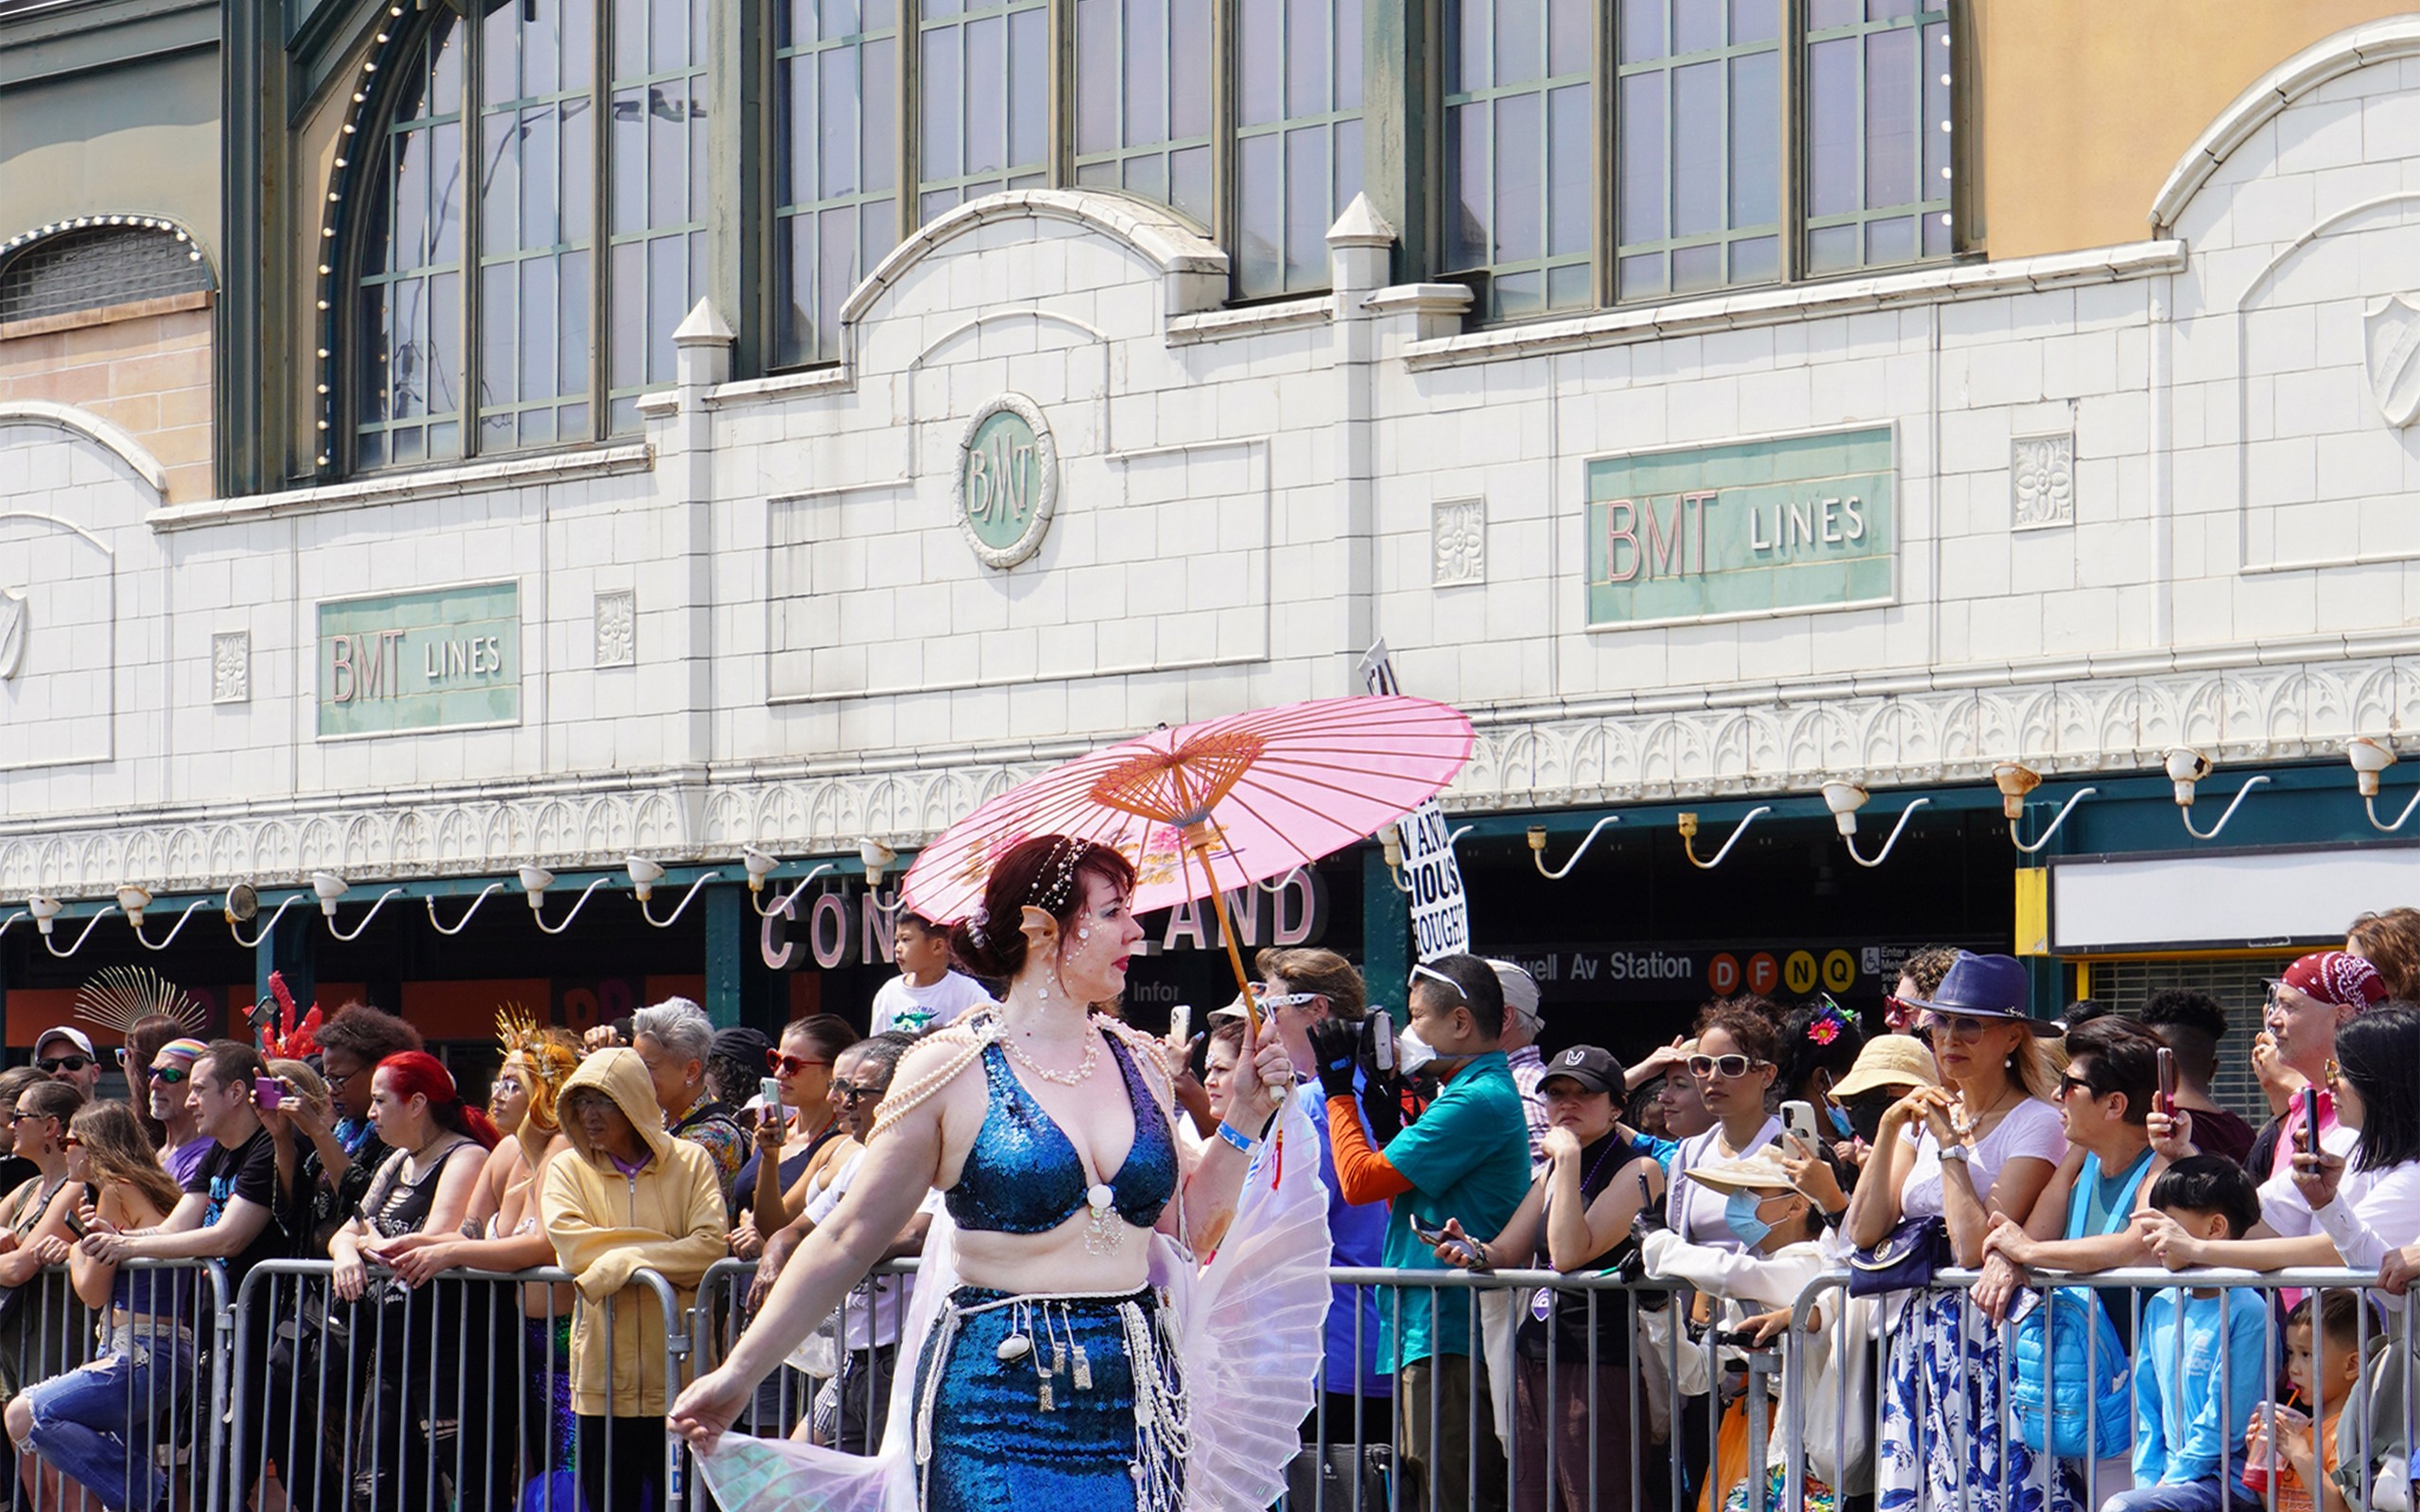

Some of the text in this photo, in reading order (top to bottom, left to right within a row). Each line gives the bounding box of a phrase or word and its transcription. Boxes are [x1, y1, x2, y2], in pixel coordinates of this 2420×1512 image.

[970, 433, 1034, 523] BMT
[1607, 490, 1864, 582] BMT LINES
[332, 629, 501, 702] BMT LINES
[1131, 867, 1315, 955] AND
[1570, 953, 1598, 980] Av
[1611, 952, 1691, 980] Station
[1880, 946, 1906, 957] Enter
